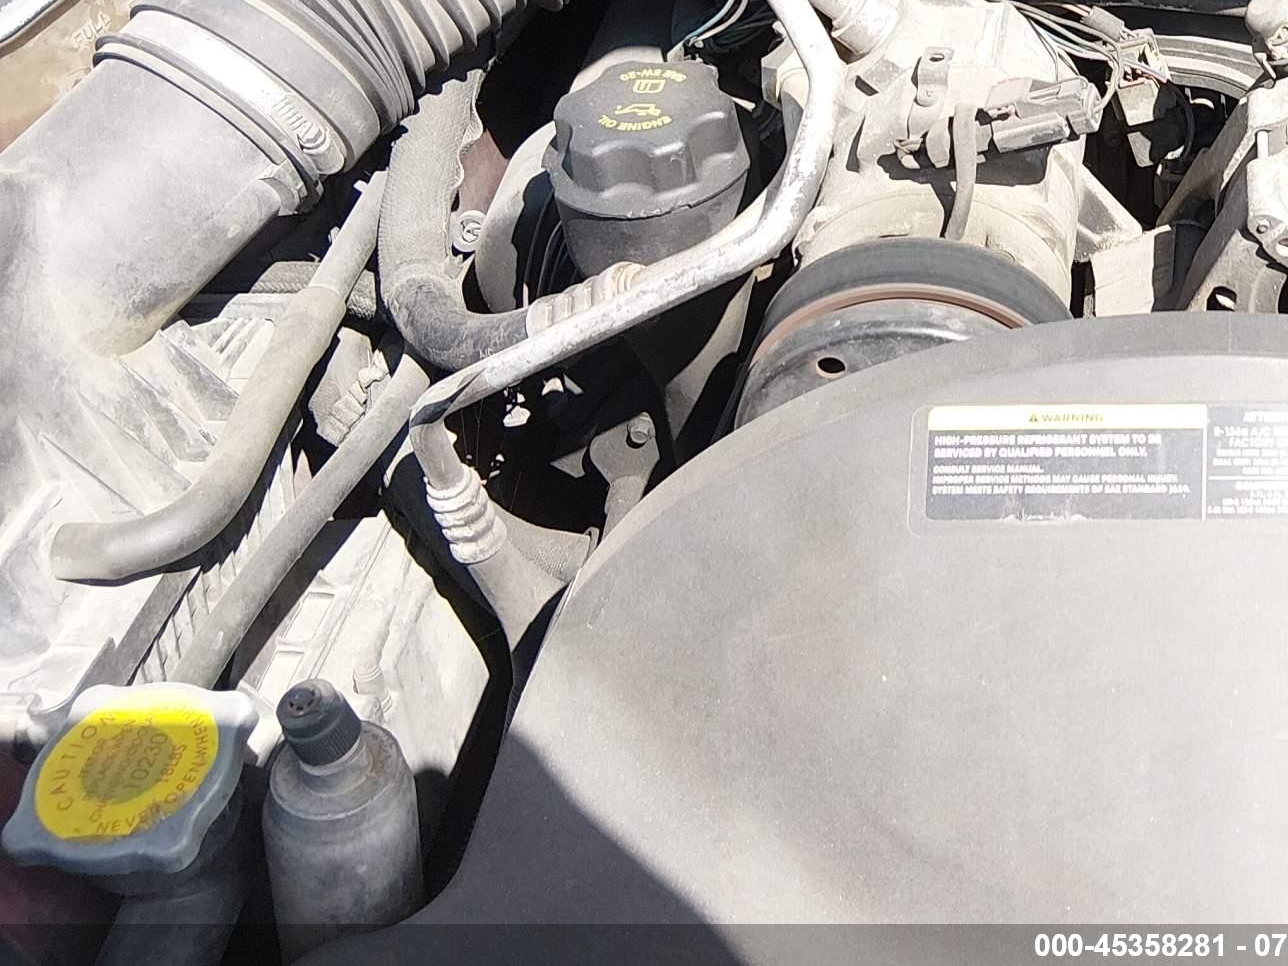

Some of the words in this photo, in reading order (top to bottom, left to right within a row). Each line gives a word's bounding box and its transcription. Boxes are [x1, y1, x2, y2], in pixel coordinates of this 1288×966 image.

[662, 69, 687, 83] SAE
[598, 114, 617, 129] OIL
[618, 115, 673, 131] ENGINE
[1041, 413, 1104, 423] WARNING
[934, 434, 1016, 446] HIGH-PRESSURE
[1018, 434, 1088, 446] REFRIGERANT
[1089, 434, 1130, 446] SYSTEM
[1132, 434, 1147, 446] TO
[934, 446, 983, 459] SERVICED
[984, 446, 997, 459] BY
[999, 446, 1053, 459] QUALIFIED
[1056, 446, 1116, 459] PERSONNEL
[1118, 446, 1148, 459] ONLY.
[932, 464, 971, 474] CONSULT
[972, 464, 1006, 474] SERVICE
[975, 474, 1010, 485] SERVICE
[1052, 474, 1071, 485] MAY
[1072, 474, 1100, 485] CAUSE
[1102, 474, 1146, 485] PERSONAL
[49, 714, 117, 811] CAUTION
[124, 733, 169, 790] 10230
[96, 800, 162, 835] NEVER
[164, 762, 200, 805] OPEN
